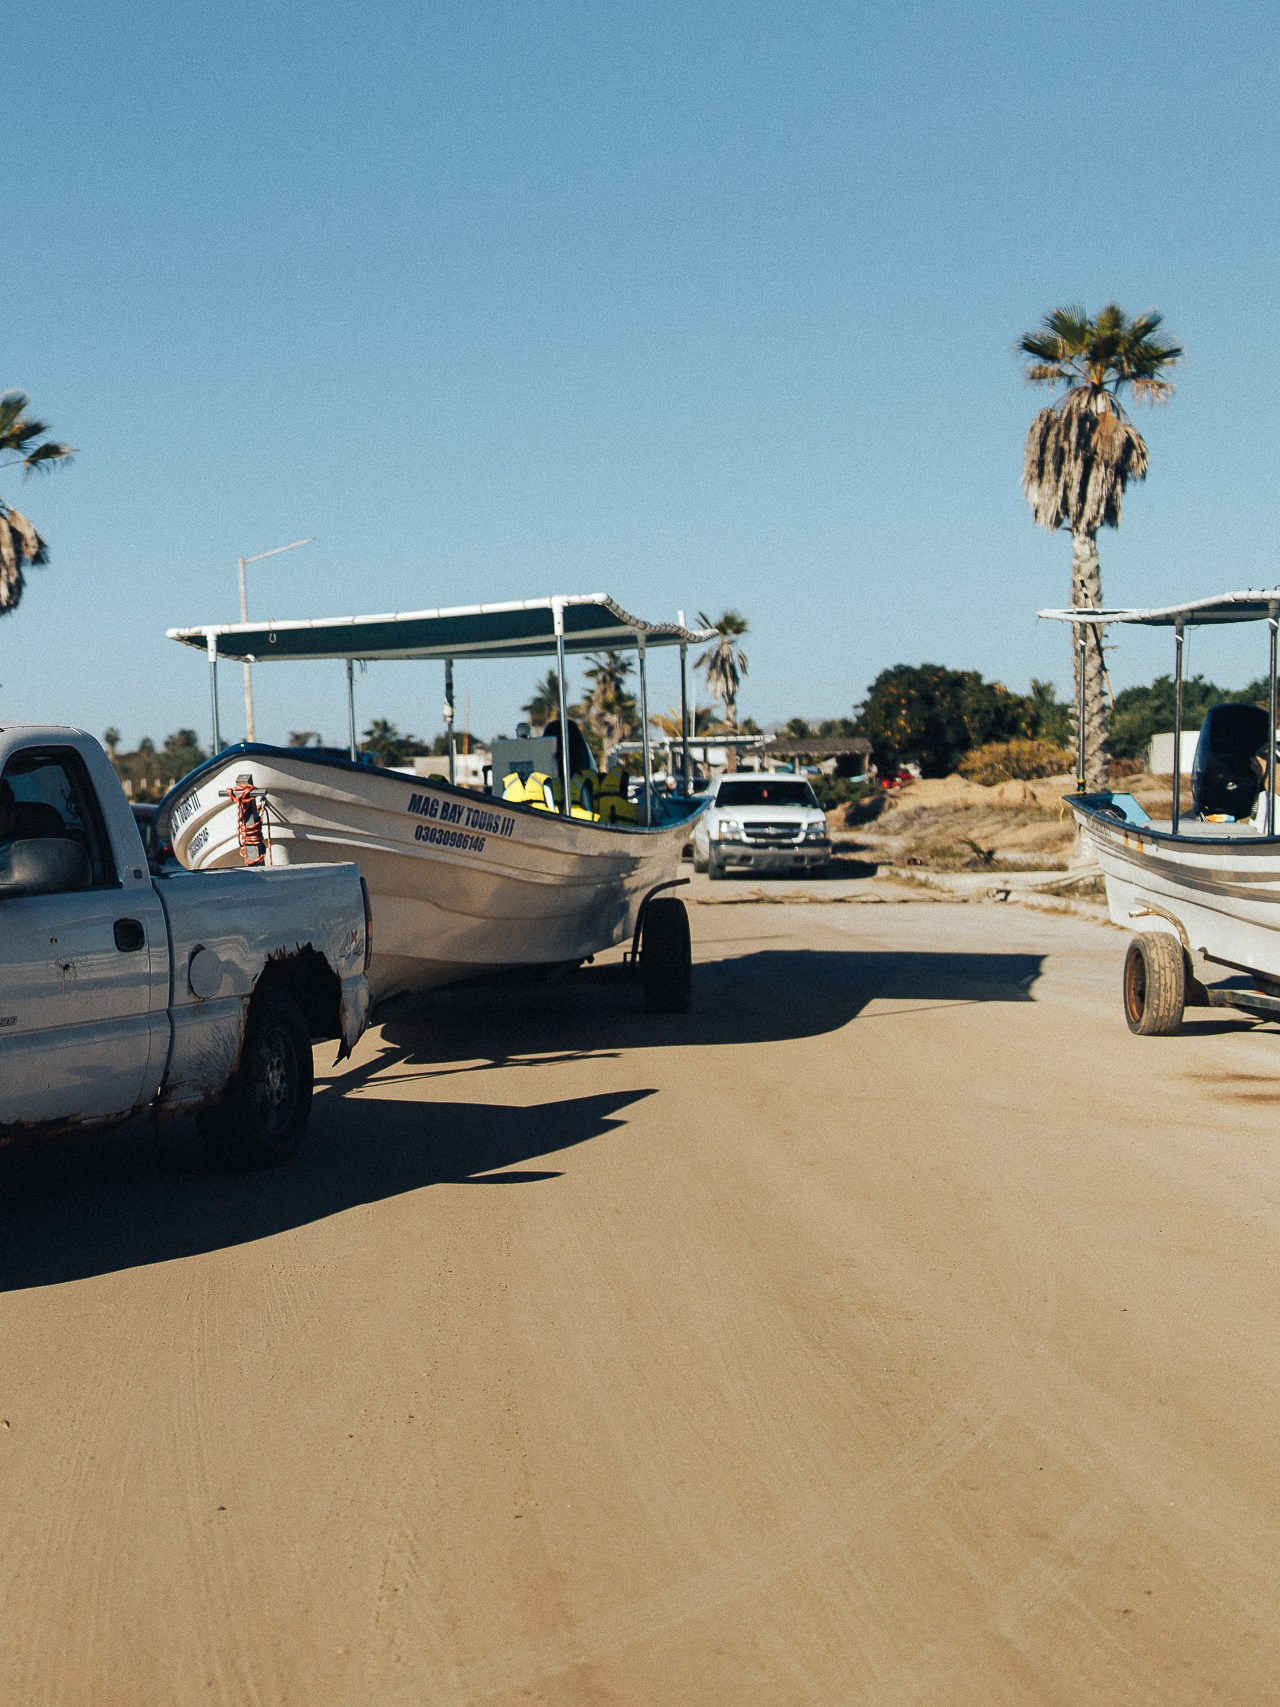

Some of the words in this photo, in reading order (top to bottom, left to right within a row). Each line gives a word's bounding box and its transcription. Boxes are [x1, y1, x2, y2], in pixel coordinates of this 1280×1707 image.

[407, 793, 439, 818] MAG
[440, 802, 464, 824] BAY
[465, 807, 501, 833] TOURS
[500, 817, 515, 837] III
